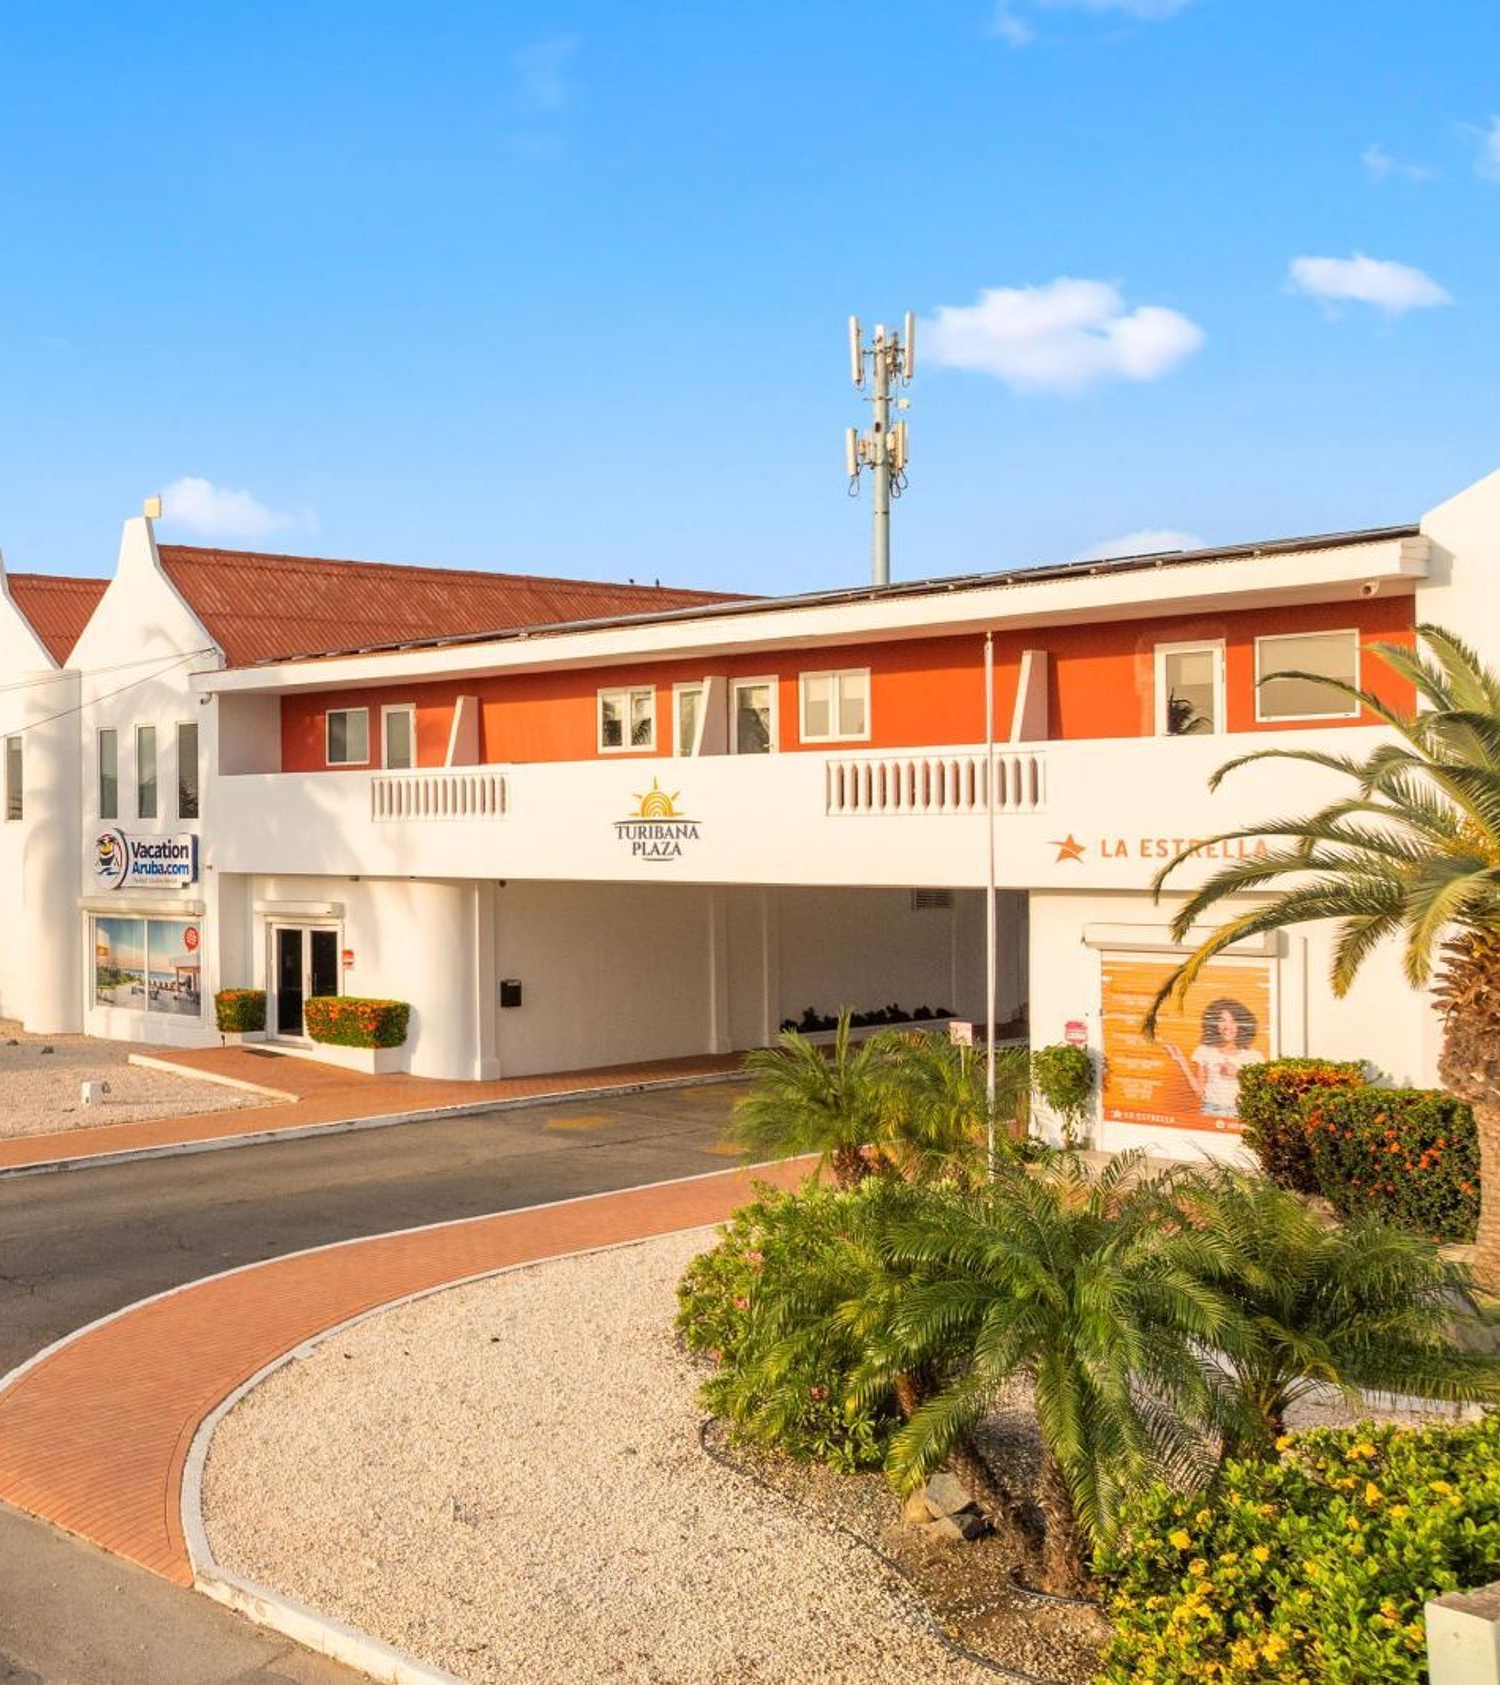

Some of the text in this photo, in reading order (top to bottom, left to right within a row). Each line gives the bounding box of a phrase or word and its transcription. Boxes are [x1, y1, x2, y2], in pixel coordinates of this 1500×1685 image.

[614, 825, 699, 840] TURIBANA
[131, 839, 189, 859] Vacation
[632, 841, 682, 856] PLAZA
[1101, 838, 1268, 859] LA ESTRELLA
[131, 860, 189, 875] Aruba.com
